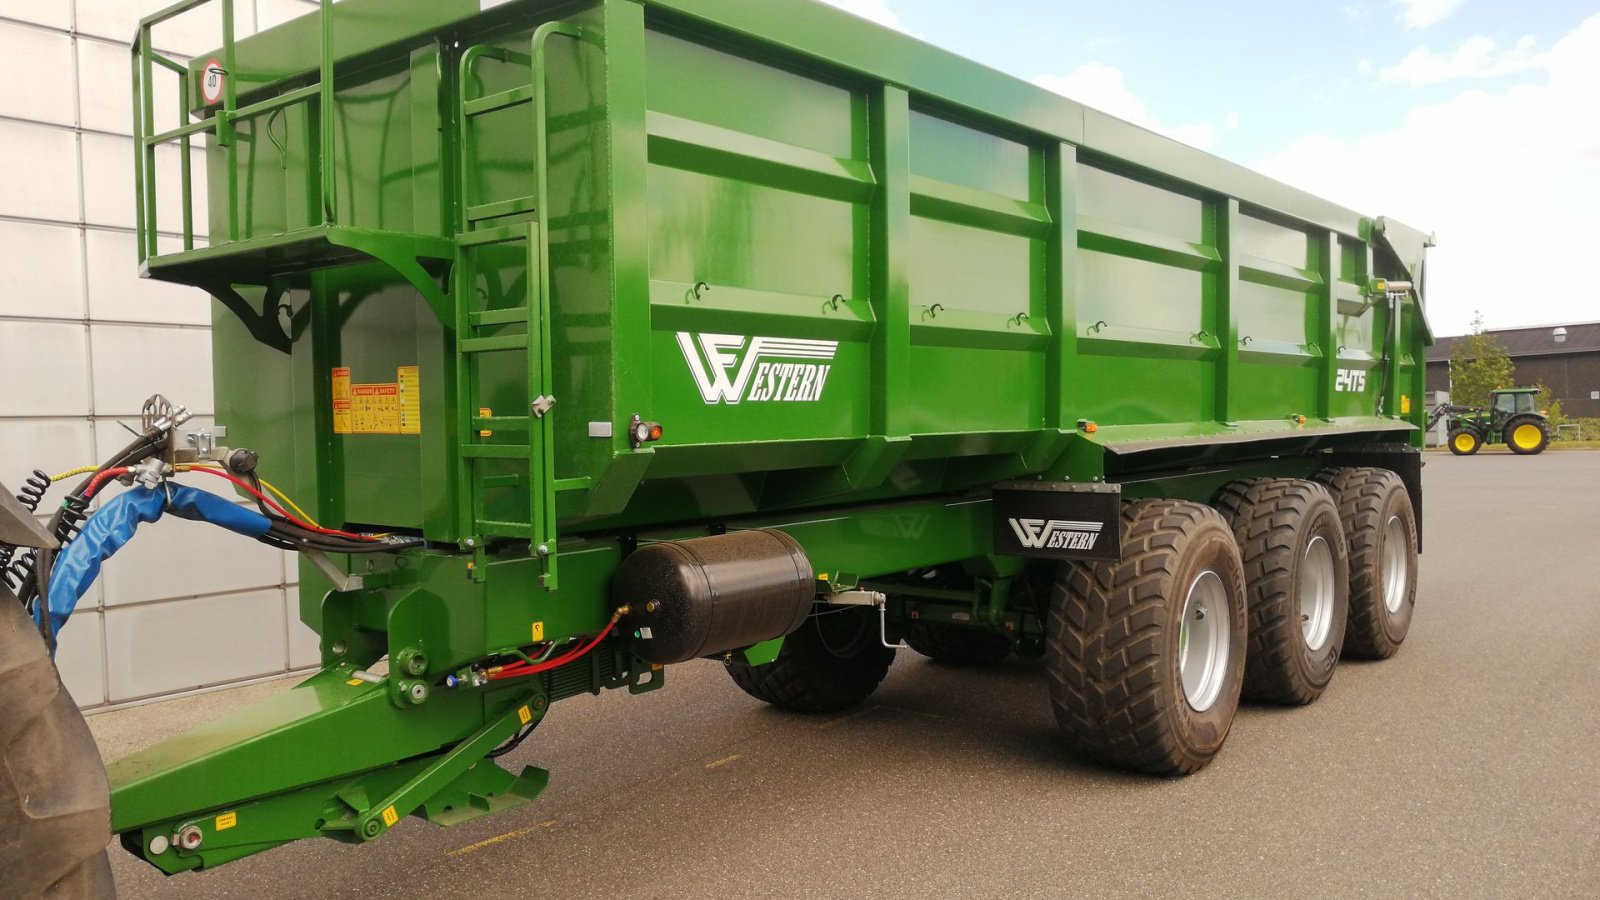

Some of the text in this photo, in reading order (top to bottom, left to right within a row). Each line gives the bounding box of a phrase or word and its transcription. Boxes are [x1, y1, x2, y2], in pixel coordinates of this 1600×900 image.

[208, 74, 216, 88] 40
[676, 331, 839, 405] WESTERN
[1008, 517, 1104, 551] WESTERN
